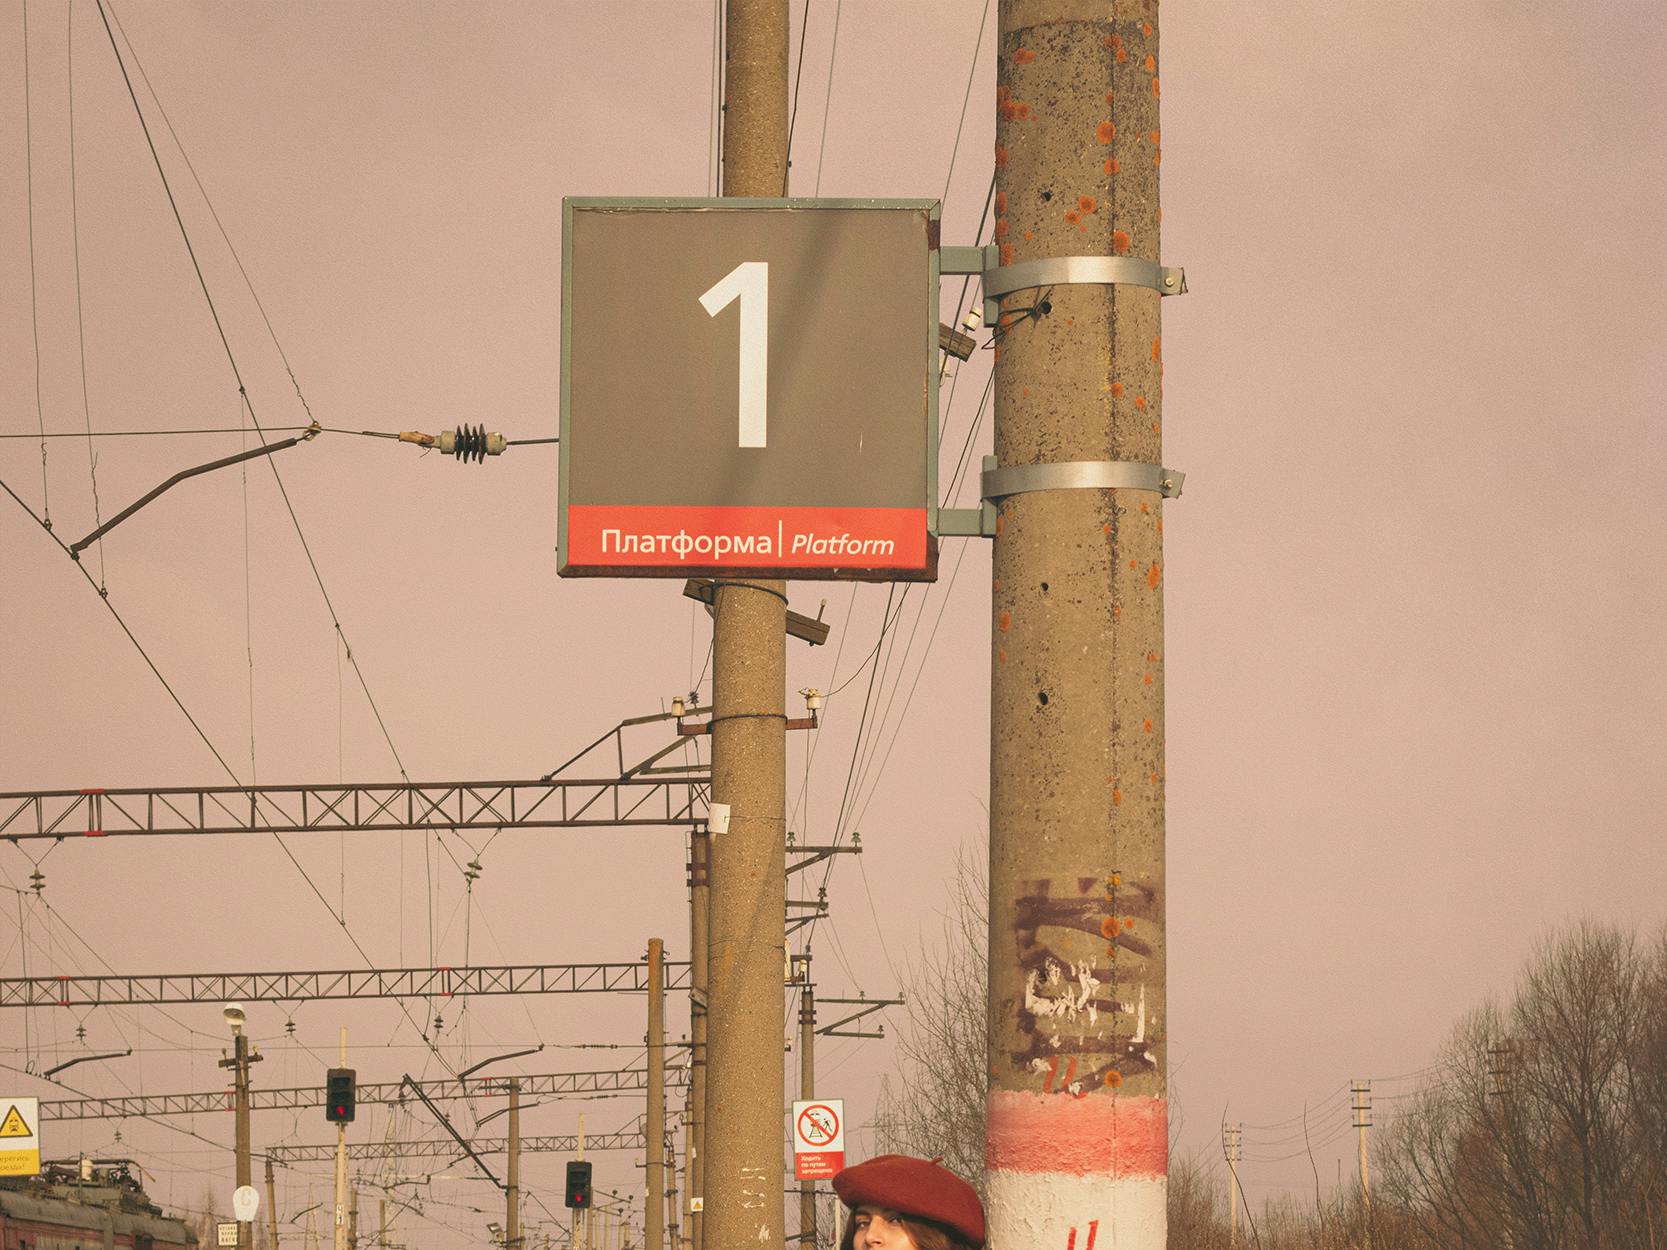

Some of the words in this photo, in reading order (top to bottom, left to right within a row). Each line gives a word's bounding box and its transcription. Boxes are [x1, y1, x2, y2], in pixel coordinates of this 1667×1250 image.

[698, 262, 769, 448] 1
[601, 529, 772, 560] Платформа
[791, 533, 895, 555] Platform
